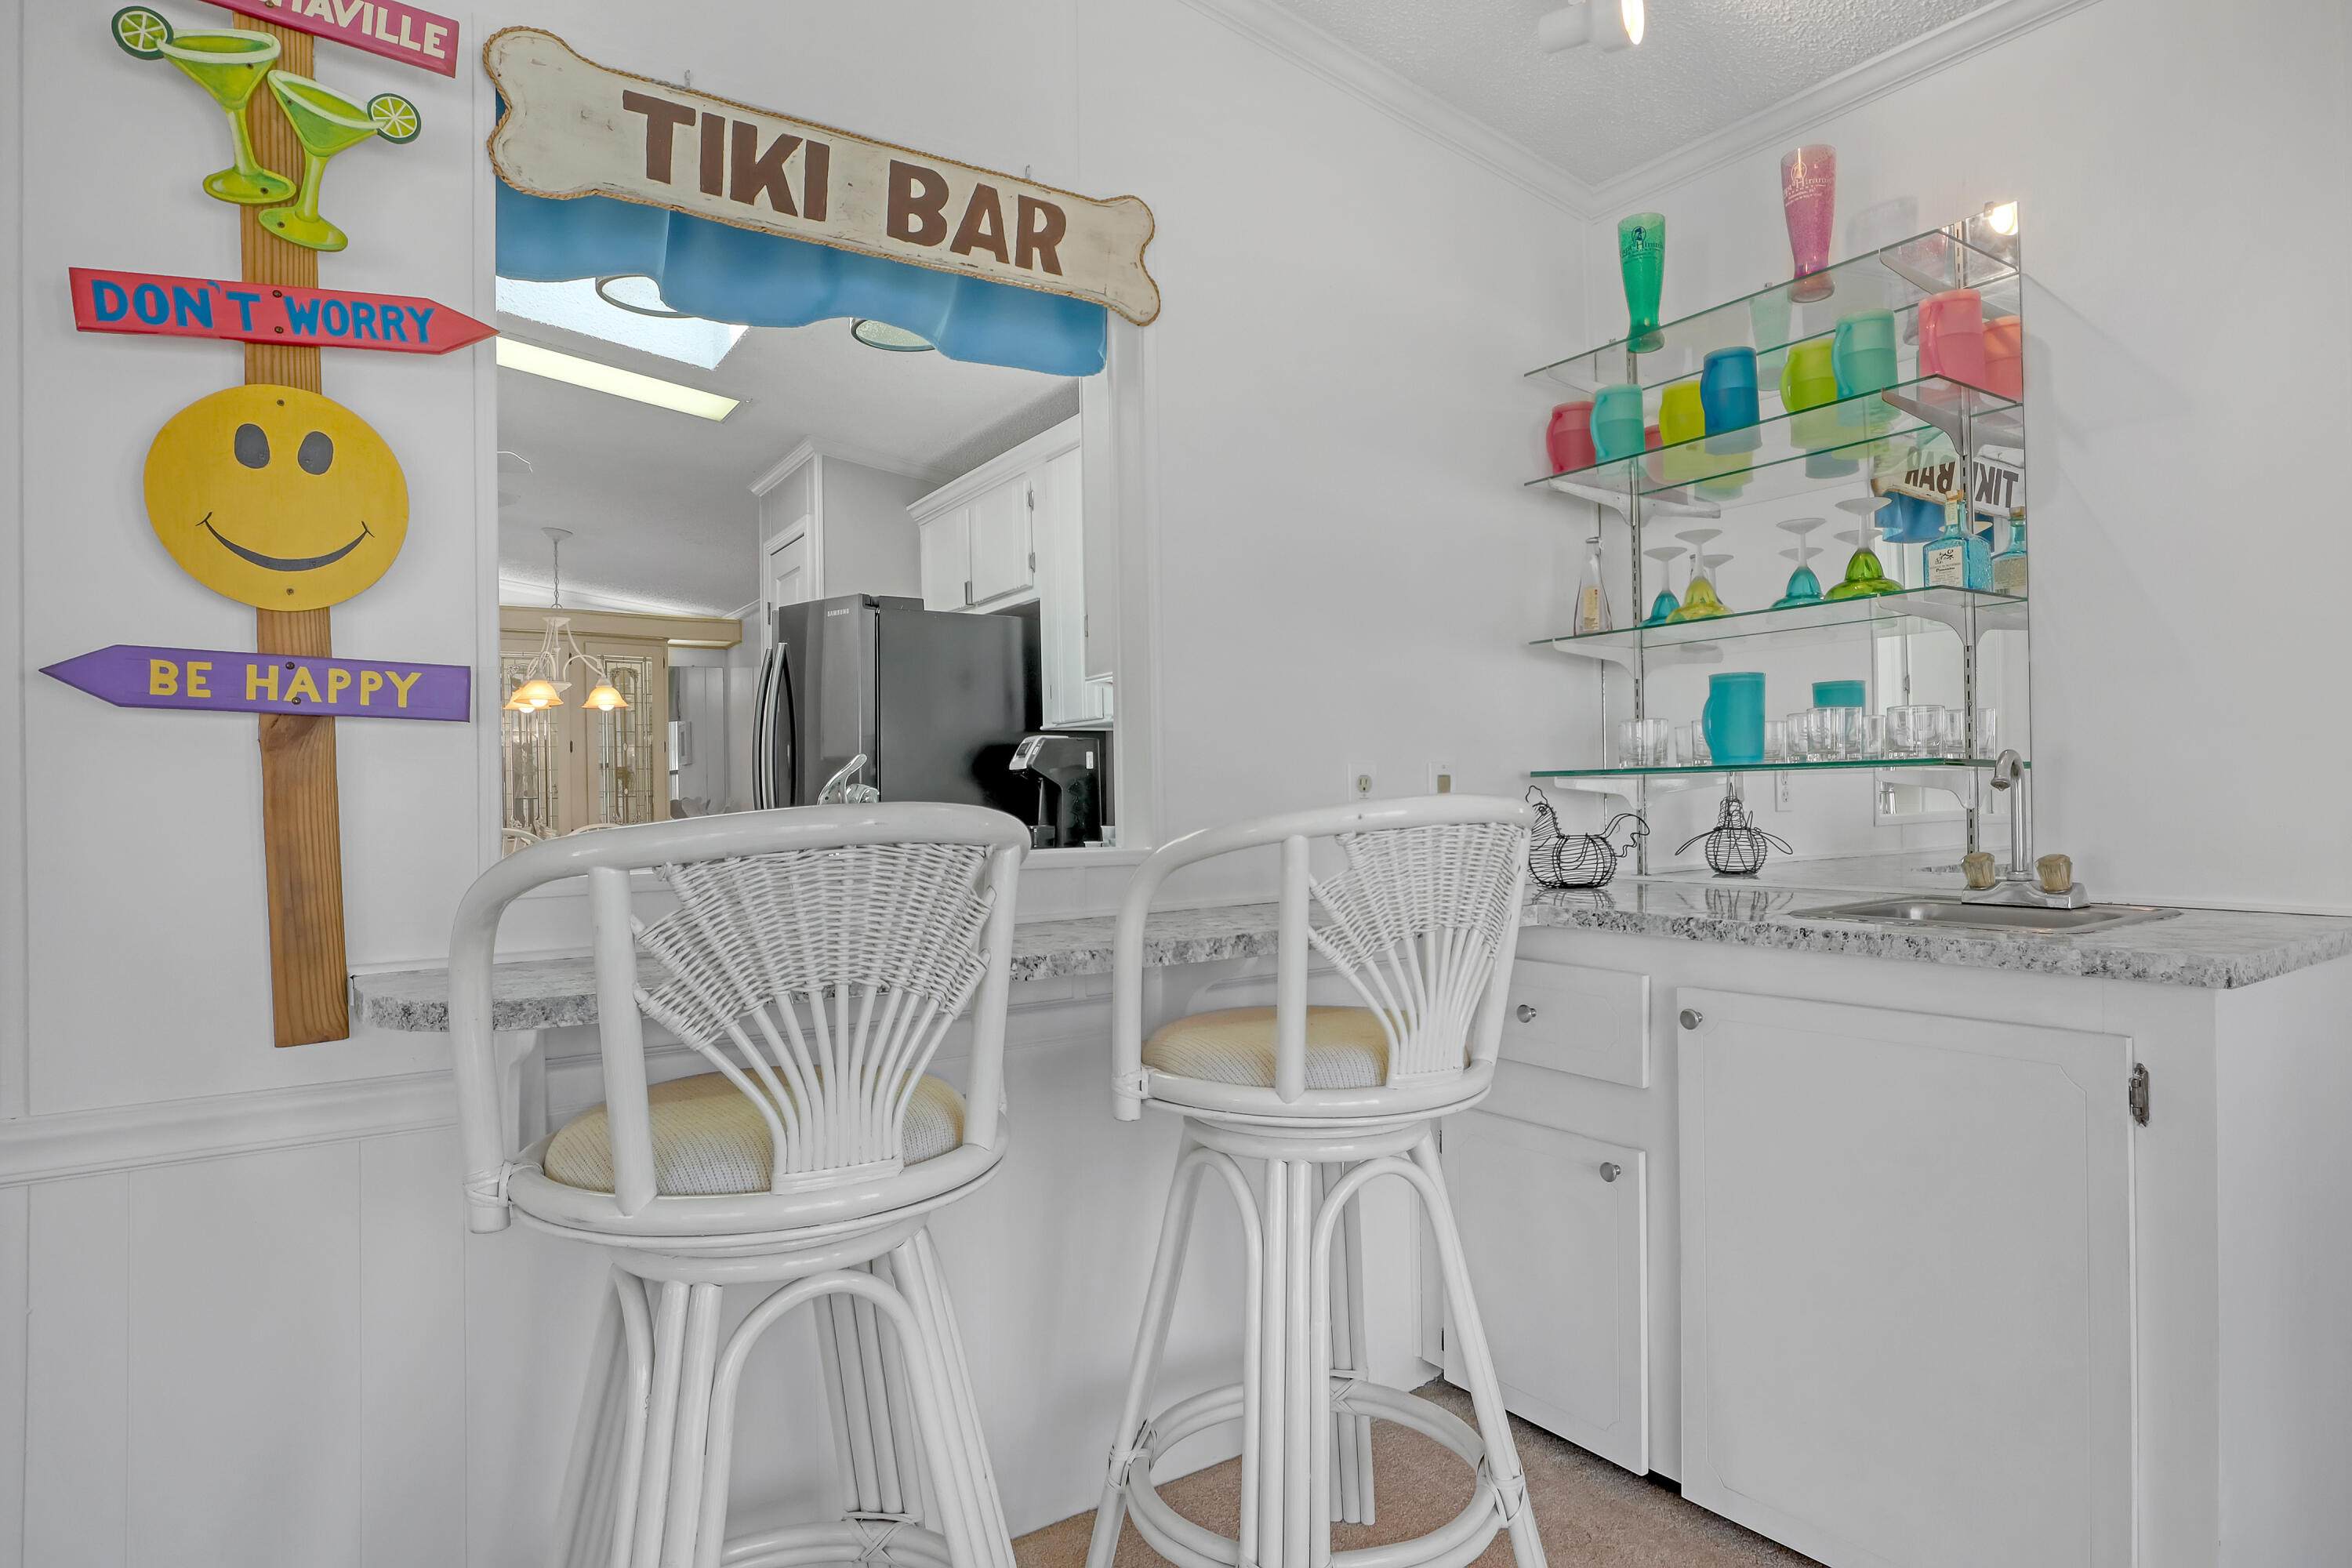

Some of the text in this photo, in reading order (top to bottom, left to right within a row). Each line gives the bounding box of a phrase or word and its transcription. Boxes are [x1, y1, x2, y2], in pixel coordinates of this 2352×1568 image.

[622, 90, 1067, 276] TIKI BAR
[91, 279, 435, 344] DON'T WORRY
[827, 608, 850, 617] SAMSUNG
[149, 659, 423, 708] BE HAPPY
